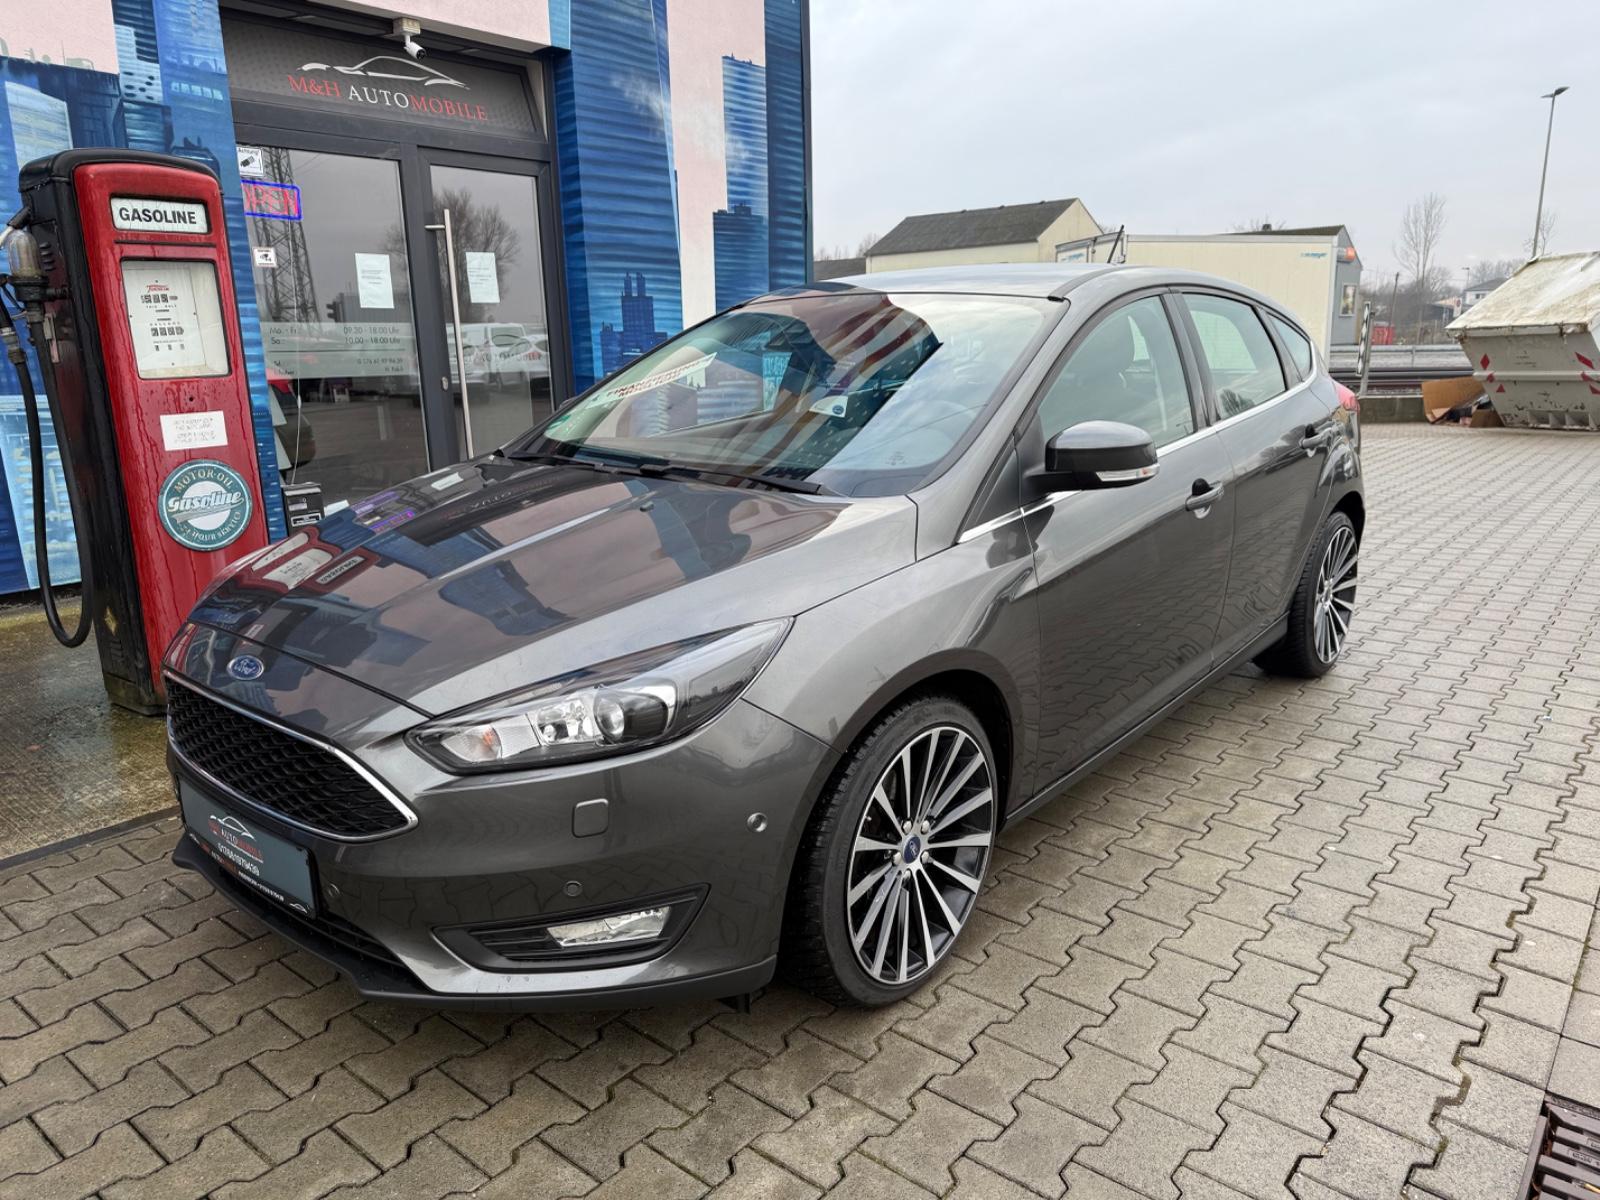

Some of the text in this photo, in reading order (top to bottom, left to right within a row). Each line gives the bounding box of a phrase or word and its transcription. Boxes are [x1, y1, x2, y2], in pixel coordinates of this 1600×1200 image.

[288, 74, 488, 121] M&H AUTOMOBILE
[118, 206, 197, 225] GASOLINE
[167, 491, 242, 513] Gasoline
